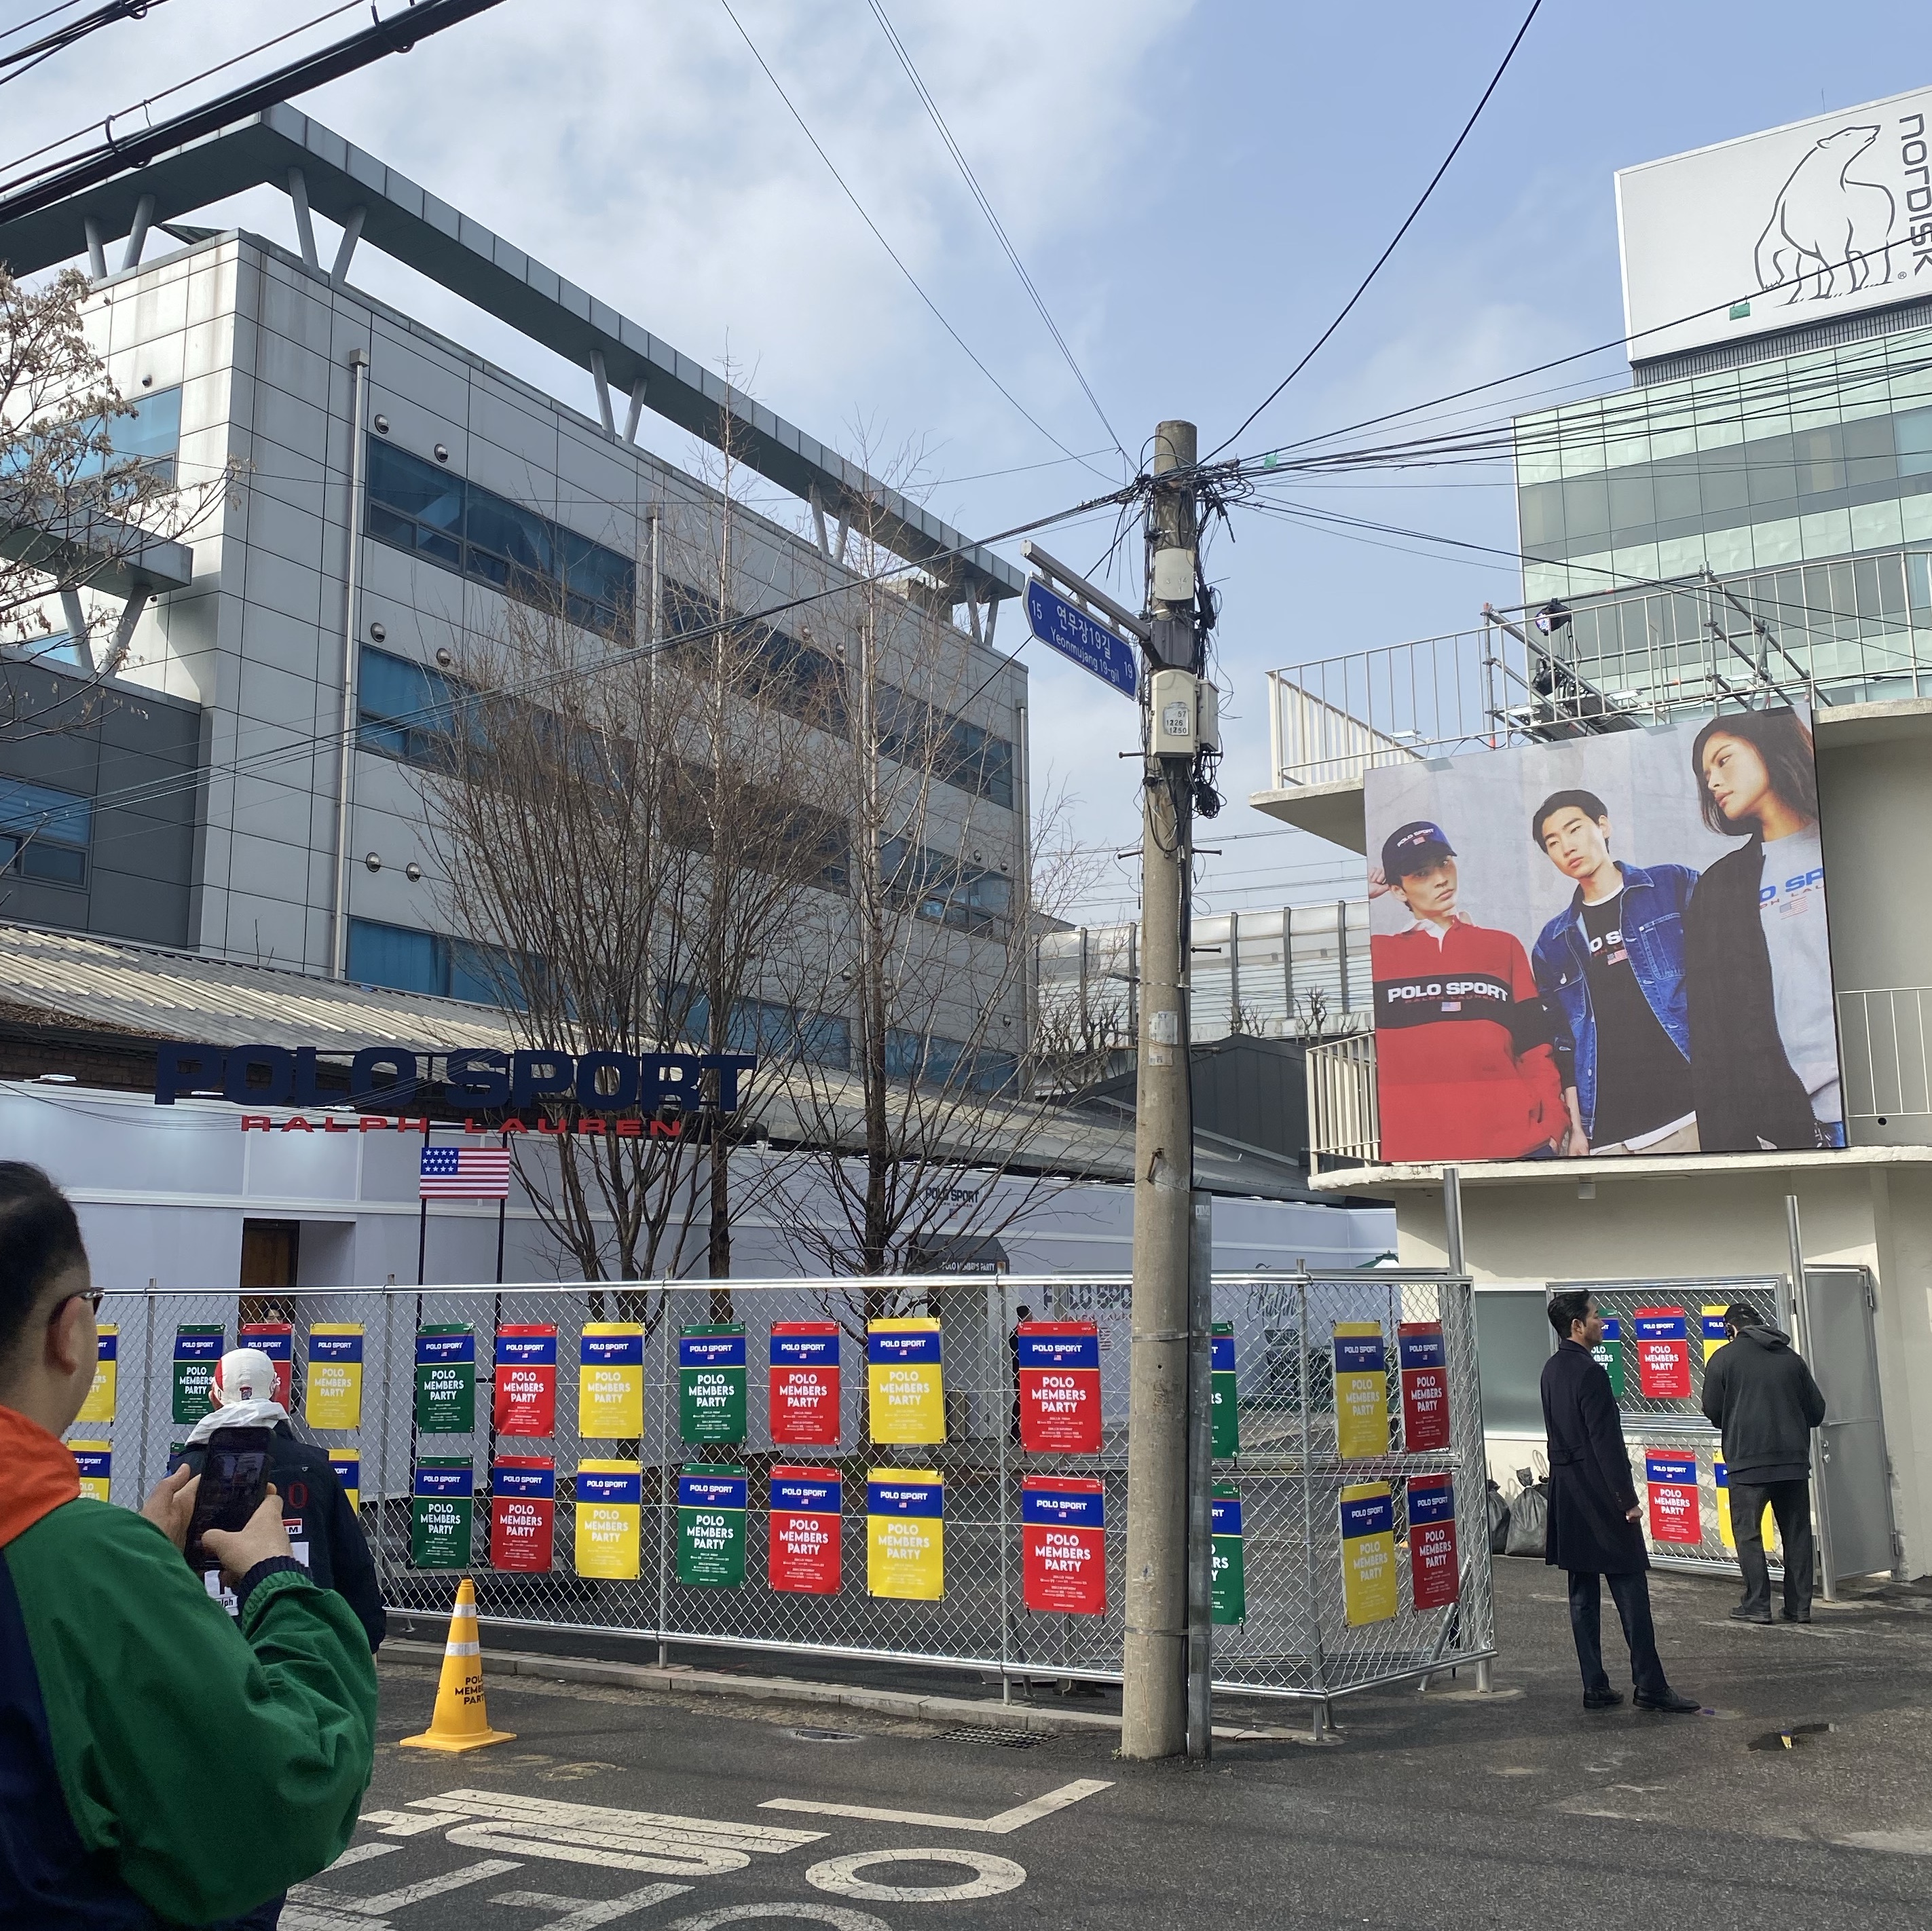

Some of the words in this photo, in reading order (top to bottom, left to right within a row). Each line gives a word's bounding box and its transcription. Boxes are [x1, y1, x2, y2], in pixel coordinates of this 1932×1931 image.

[1032, 600, 1042, 620] 15
[1057, 605, 1111, 660] 연무장19길
[1051, 626, 1098, 671] Yeonmujang
[1100, 658, 1119, 683] 19-gil
[1124, 661, 1132, 679] 19
[1397, 834, 1413, 847] POLO
[1388, 983, 1441, 1003] POLO
[1446, 982, 1508, 1002] SPORT
[155, 1044, 417, 1105] POLO
[445, 1048, 757, 1112] SPORT
[242, 1114, 428, 1133] RALPH
[465, 1117, 682, 1136] LAUREN
[951, 1190, 979, 1203] SPORT
[980, 1262, 995, 1271] PARTY
[1650, 1346, 1671, 1354] POLO
[1645, 1354, 1679, 1362] MEMBERS
[187, 1366, 206, 1375] POLO
[1651, 1362, 1673, 1370] PARTY
[322, 1368, 344, 1377] POLO
[432, 1370, 456, 1380] POLO
[512, 1372, 536, 1382] POLO
[596, 1372, 620, 1381] POLO
[889, 1371, 918, 1381] POLO
[315, 1379, 352, 1387] MEMBERS
[698, 1374, 725, 1385] POLO
[789, 1374, 817, 1385] POLO
[1043, 1377, 1075, 1387] POLO
[1352, 1379, 1373, 1390] POLO
[1417, 1376, 1436, 1387] POLO
[185, 1386, 207, 1394] PARTY
[424, 1380, 464, 1390] MEMBERS
[504, 1383, 544, 1393] MEMBERS
[588, 1383, 631, 1392] MEMBERS
[779, 1385, 827, 1395] MEMBERS
[880, 1383, 929, 1393] MEMBERS
[320, 1388, 345, 1397] PARTY
[430, 1391, 457, 1400] PARTY
[689, 1386, 735, 1396] MEMBERS
[1032, 1389, 1086, 1400] MEMBERS
[1411, 1388, 1442, 1401] MEMBERS
[510, 1393, 536, 1402] PARTY
[595, 1394, 623, 1404] PARTY
[696, 1397, 726, 1407] PARTY
[787, 1398, 819, 1407] PARTY
[889, 1395, 921, 1405] PARTY
[1345, 1392, 1379, 1404] MEMBERS
[1041, 1402, 1077, 1412] PARTY
[1353, 1404, 1374, 1416] PARTY
[1417, 1400, 1438, 1412] PARTY
[709, 1485, 733, 1493] SPORT
[1660, 1488, 1682, 1497] POLO
[901, 1492, 928, 1500] SPORT
[1037, 1500, 1058, 1508] POLO
[1060, 1501, 1087, 1510] SPORT
[1417, 1499, 1431, 1507] POLO
[1432, 1497, 1447, 1505] SPORT
[1654, 1497, 1690, 1507] MEMBERS
[428, 1504, 453, 1513] POLO
[509, 1505, 534, 1515] POLO
[1661, 1506, 1684, 1515] PARTY
[421, 1514, 460, 1524] MEMBERS
[593, 1510, 619, 1520] POLO
[500, 1515, 542, 1526] MEMBERS
[584, 1520, 628, 1531] MEMBERS
[696, 1515, 724, 1526] POLO
[789, 1520, 819, 1531] POLO
[428, 1524, 453, 1534] PARTY
[506, 1526, 535, 1537] PARTY
[687, 1526, 734, 1539] MEMBERS
[888, 1524, 918, 1535] POLO
[592, 1533, 620, 1542] PARTY
[779, 1531, 828, 1543] MEMBERS
[878, 1535, 930, 1548] MEMBERS
[1046, 1533, 1079, 1546] POLO
[1426, 1530, 1445, 1543] POLO
[694, 1538, 725, 1550] PARTY
[787, 1543, 820, 1555] PARTY
[1360, 1541, 1380, 1555] POLO
[1419, 1541, 1451, 1557] MEMBERS
[887, 1548, 921, 1560] PARTY
[1035, 1545, 1091, 1560] MEMBERS
[1045, 1559, 1081, 1573] PARTY
[1354, 1553, 1388, 1570] MEMBERS
[1426, 1554, 1447, 1569] PARTY
[1360, 1567, 1382, 1582] PARTY
